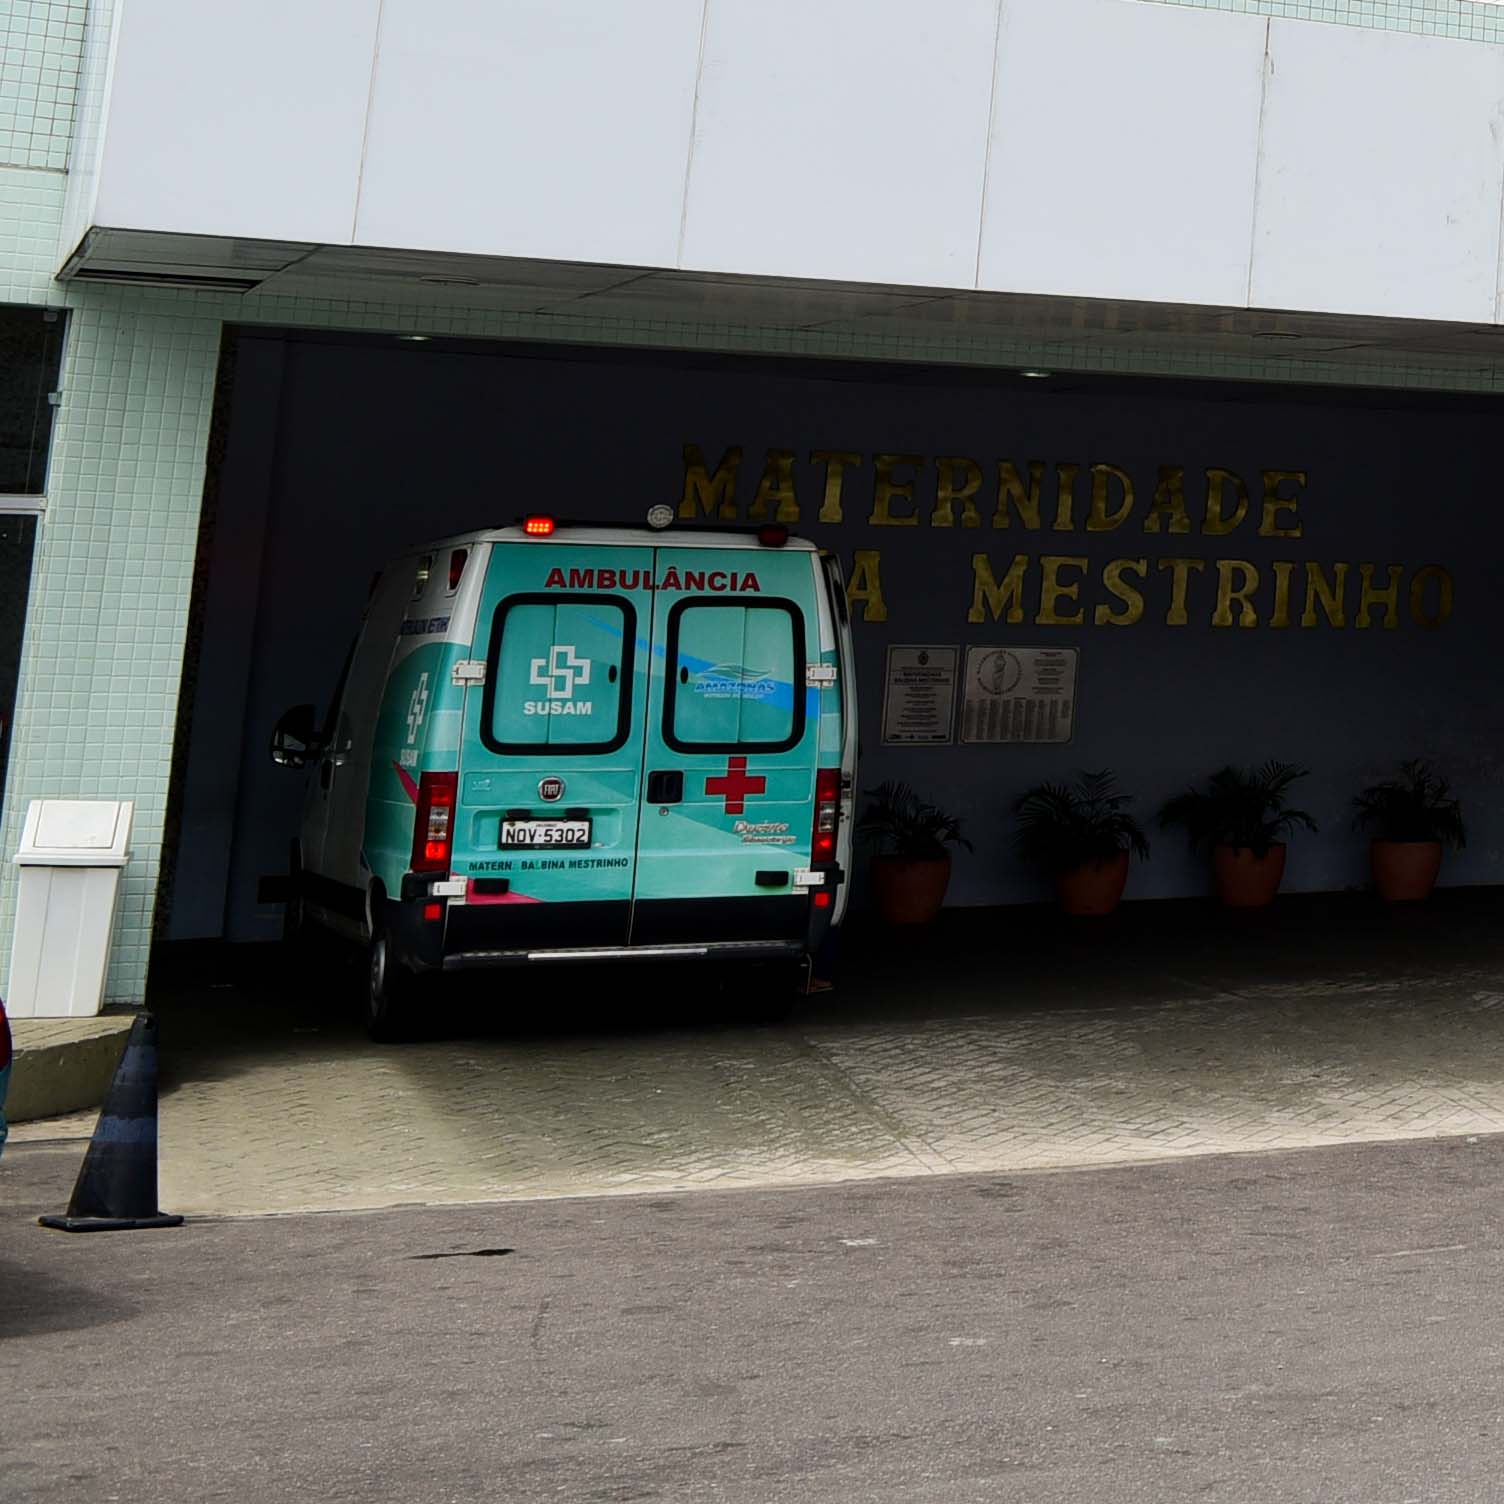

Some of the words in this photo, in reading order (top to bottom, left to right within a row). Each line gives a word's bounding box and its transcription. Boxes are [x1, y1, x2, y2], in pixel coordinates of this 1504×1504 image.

[678, 444, 1309, 539] MATERNIDADE
[544, 567, 761, 592] AMBULÂNCIA
[967, 551, 1455, 630] MESTRINHO
[523, 700, 592, 716] SUSAM
[544, 783, 559, 795] FIAT
[568, 858, 628, 869] MESTRINHO
